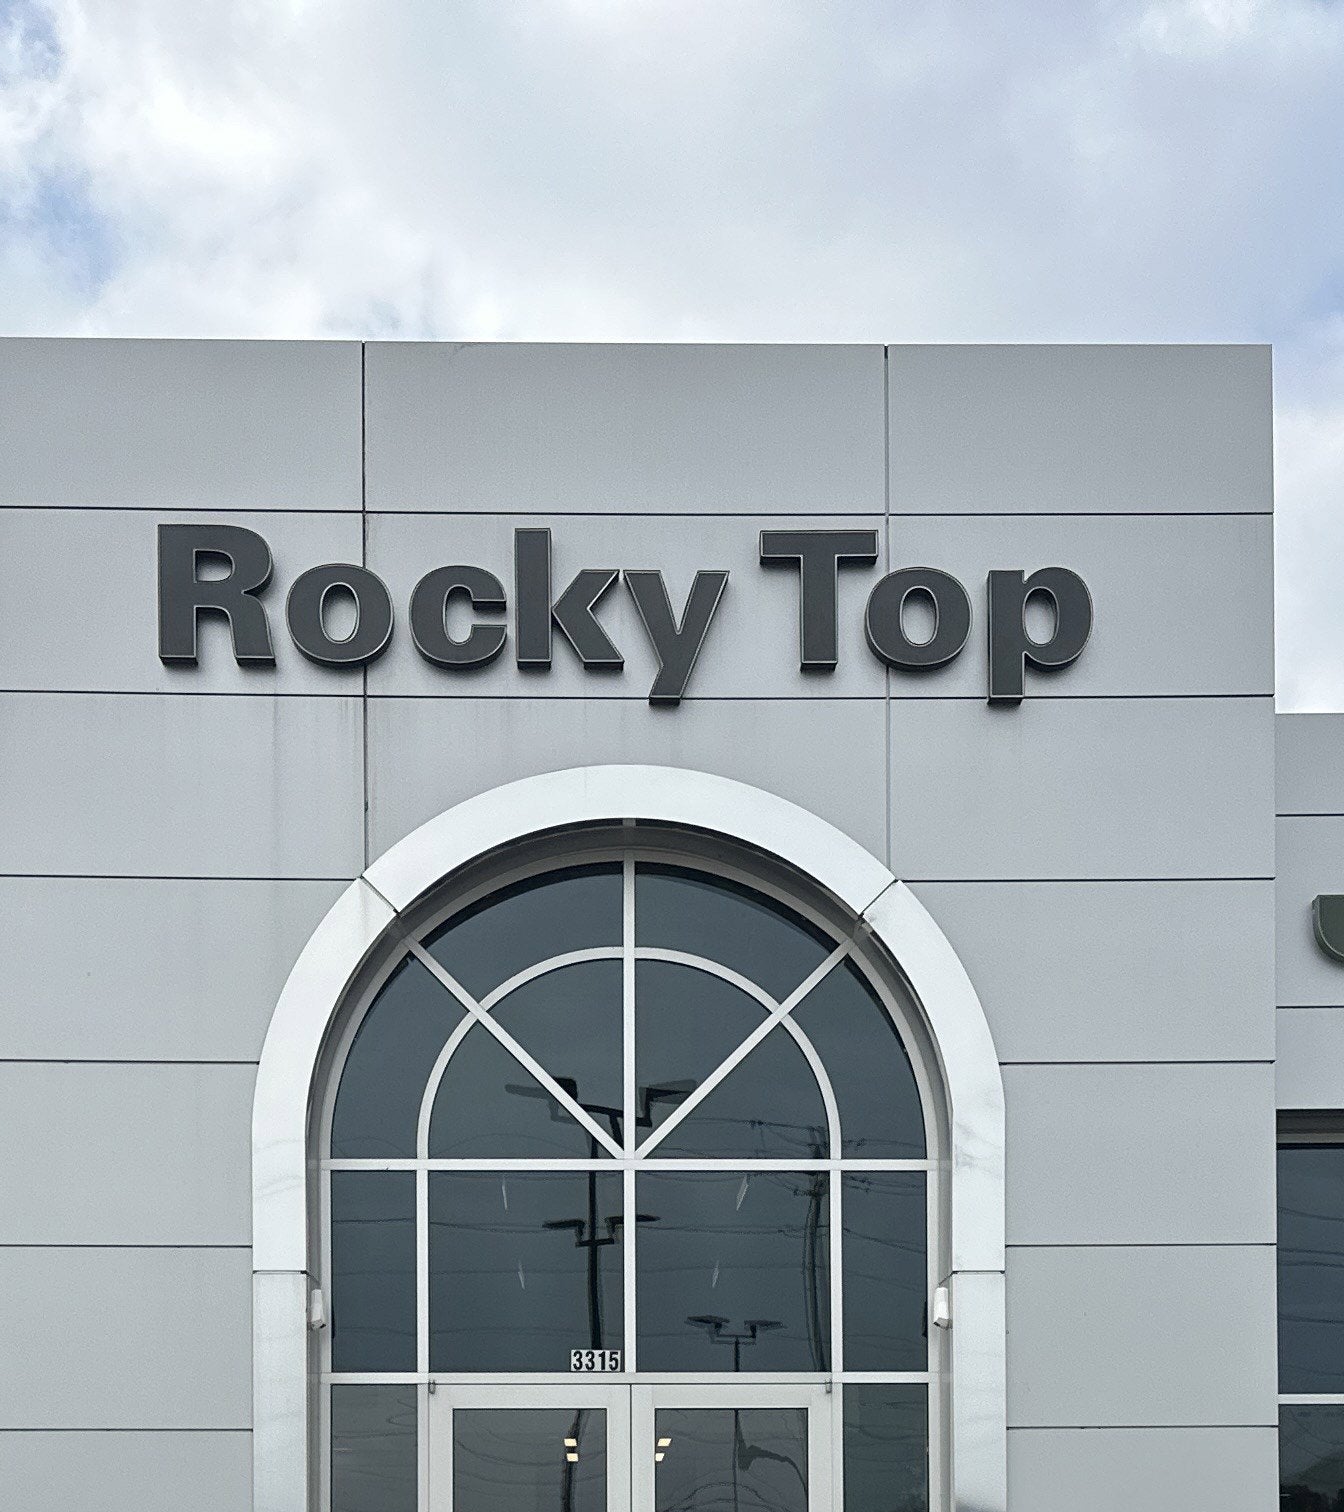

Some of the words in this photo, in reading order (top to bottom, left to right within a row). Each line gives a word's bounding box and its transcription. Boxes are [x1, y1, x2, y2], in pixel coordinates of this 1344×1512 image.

[156, 523, 730, 705] Rocky
[758, 528, 1095, 705] Top
[572, 1350, 619, 1371] 3315
